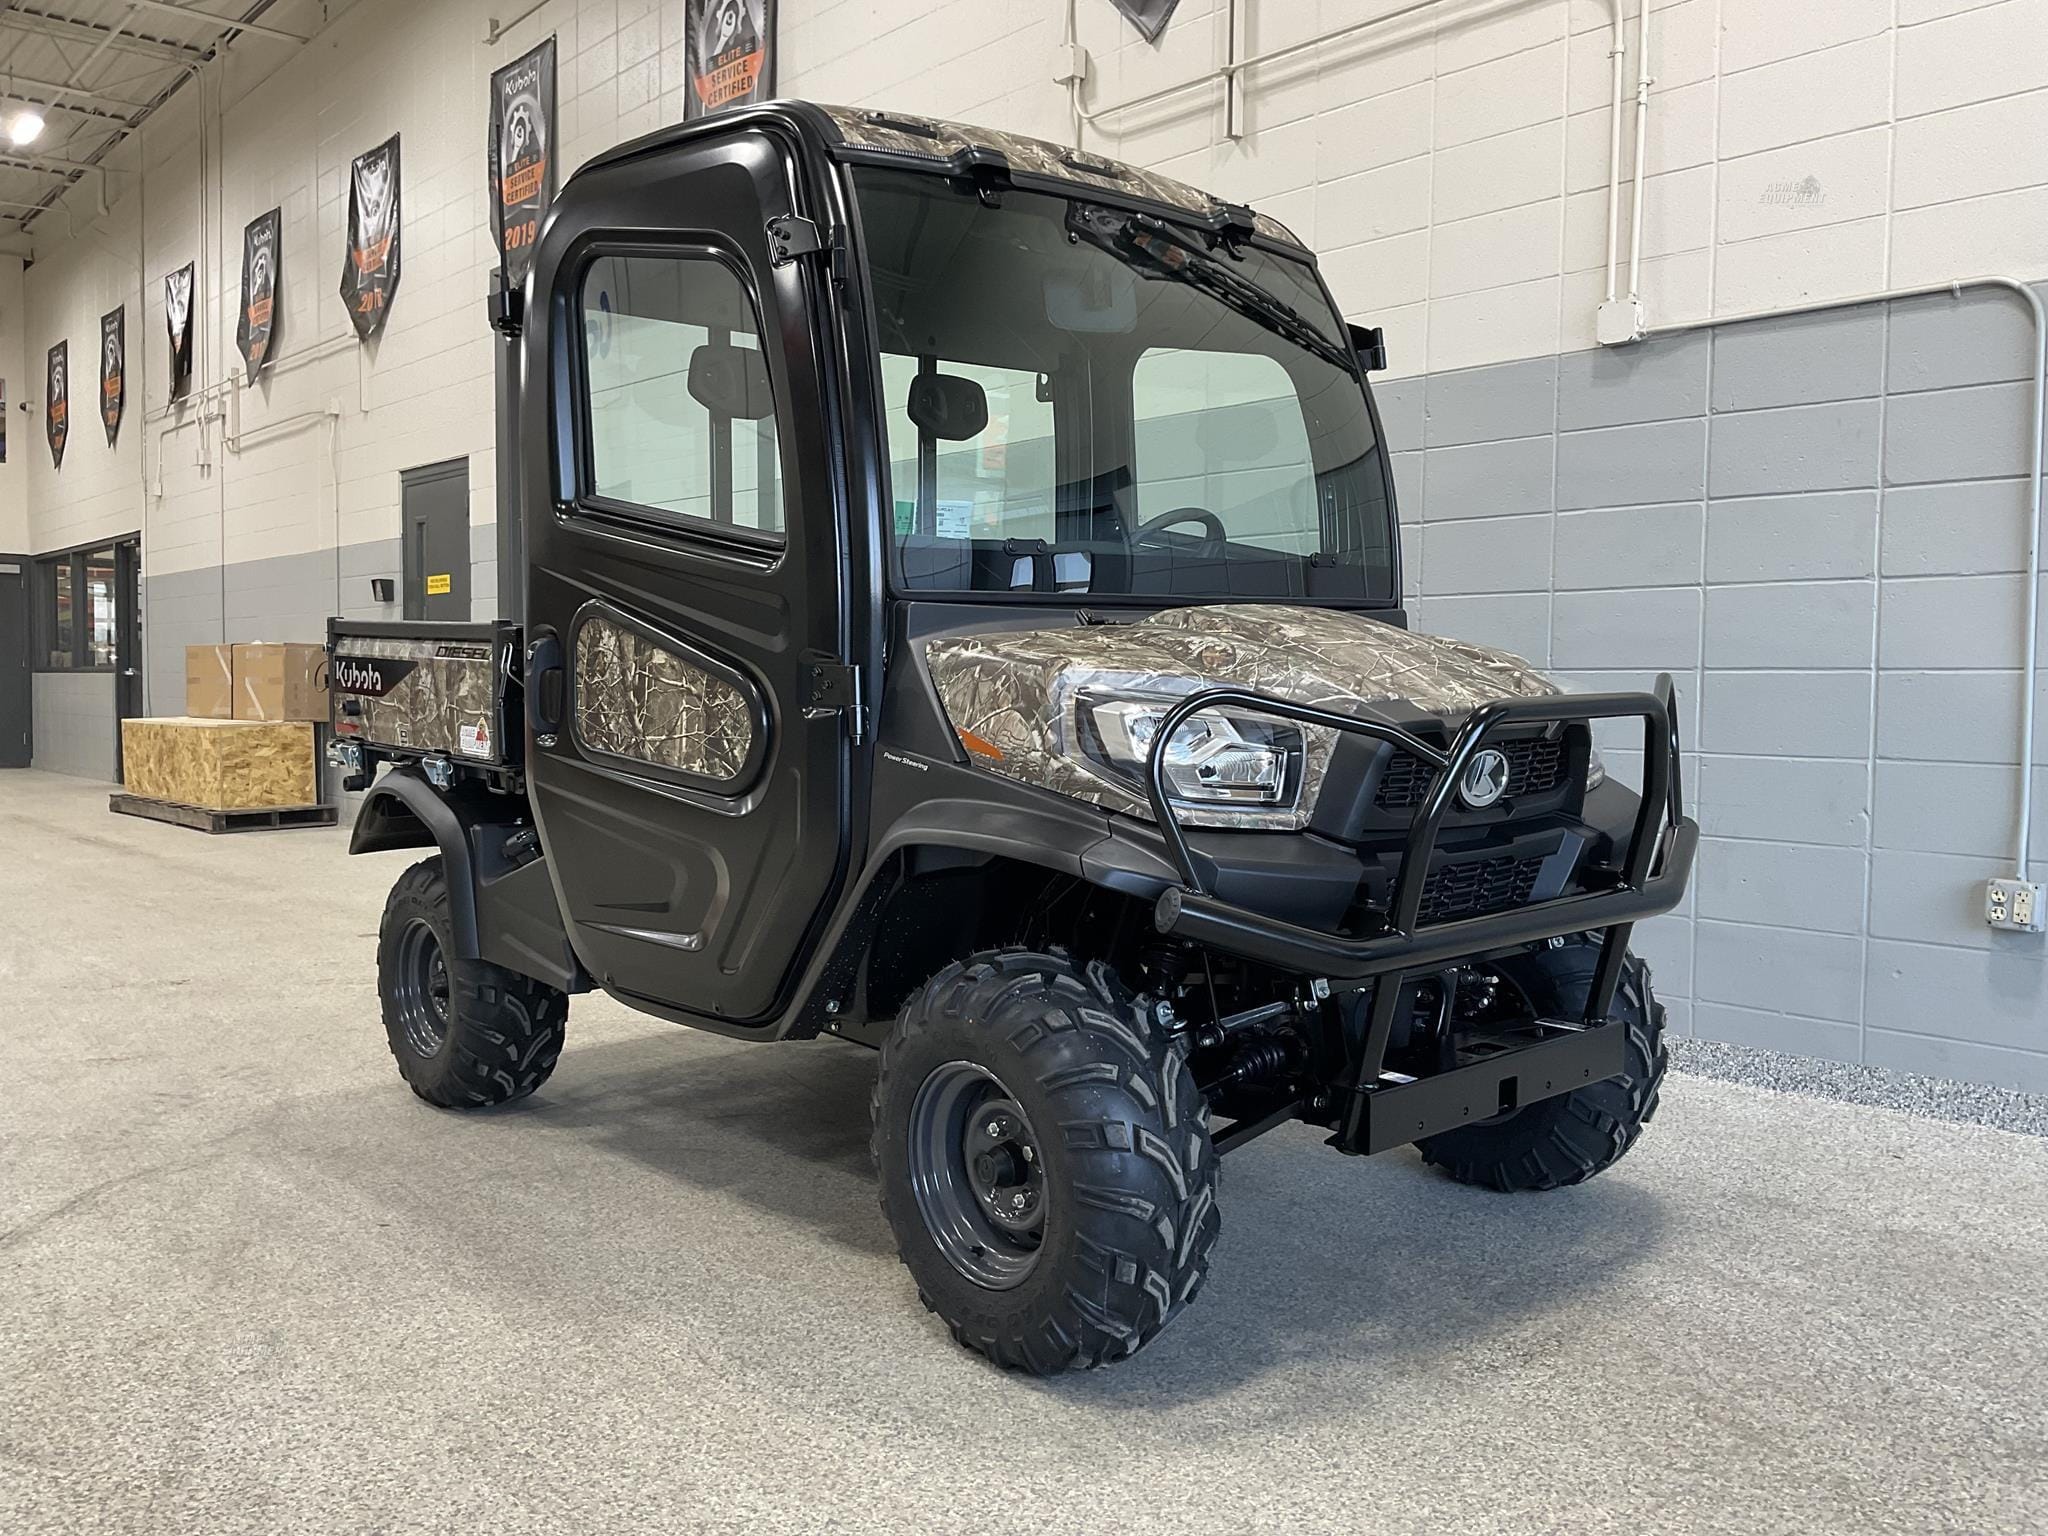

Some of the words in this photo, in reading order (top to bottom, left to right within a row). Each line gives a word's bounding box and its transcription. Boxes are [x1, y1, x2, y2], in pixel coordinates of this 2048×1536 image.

[717, 46, 742, 66] ELITE
[505, 69, 537, 95] Kubota
[711, 60, 749, 88] SERVICE
[707, 75, 753, 106] CERTIFIED
[510, 168, 535, 189] SERVICE
[506, 180, 538, 203] CERTIFIED
[505, 220, 536, 251] 2019
[434, 646, 490, 659] DIESEL
[336, 661, 382, 691] Kubota
[883, 751, 902, 762] Power
[901, 757, 928, 771] Steering
